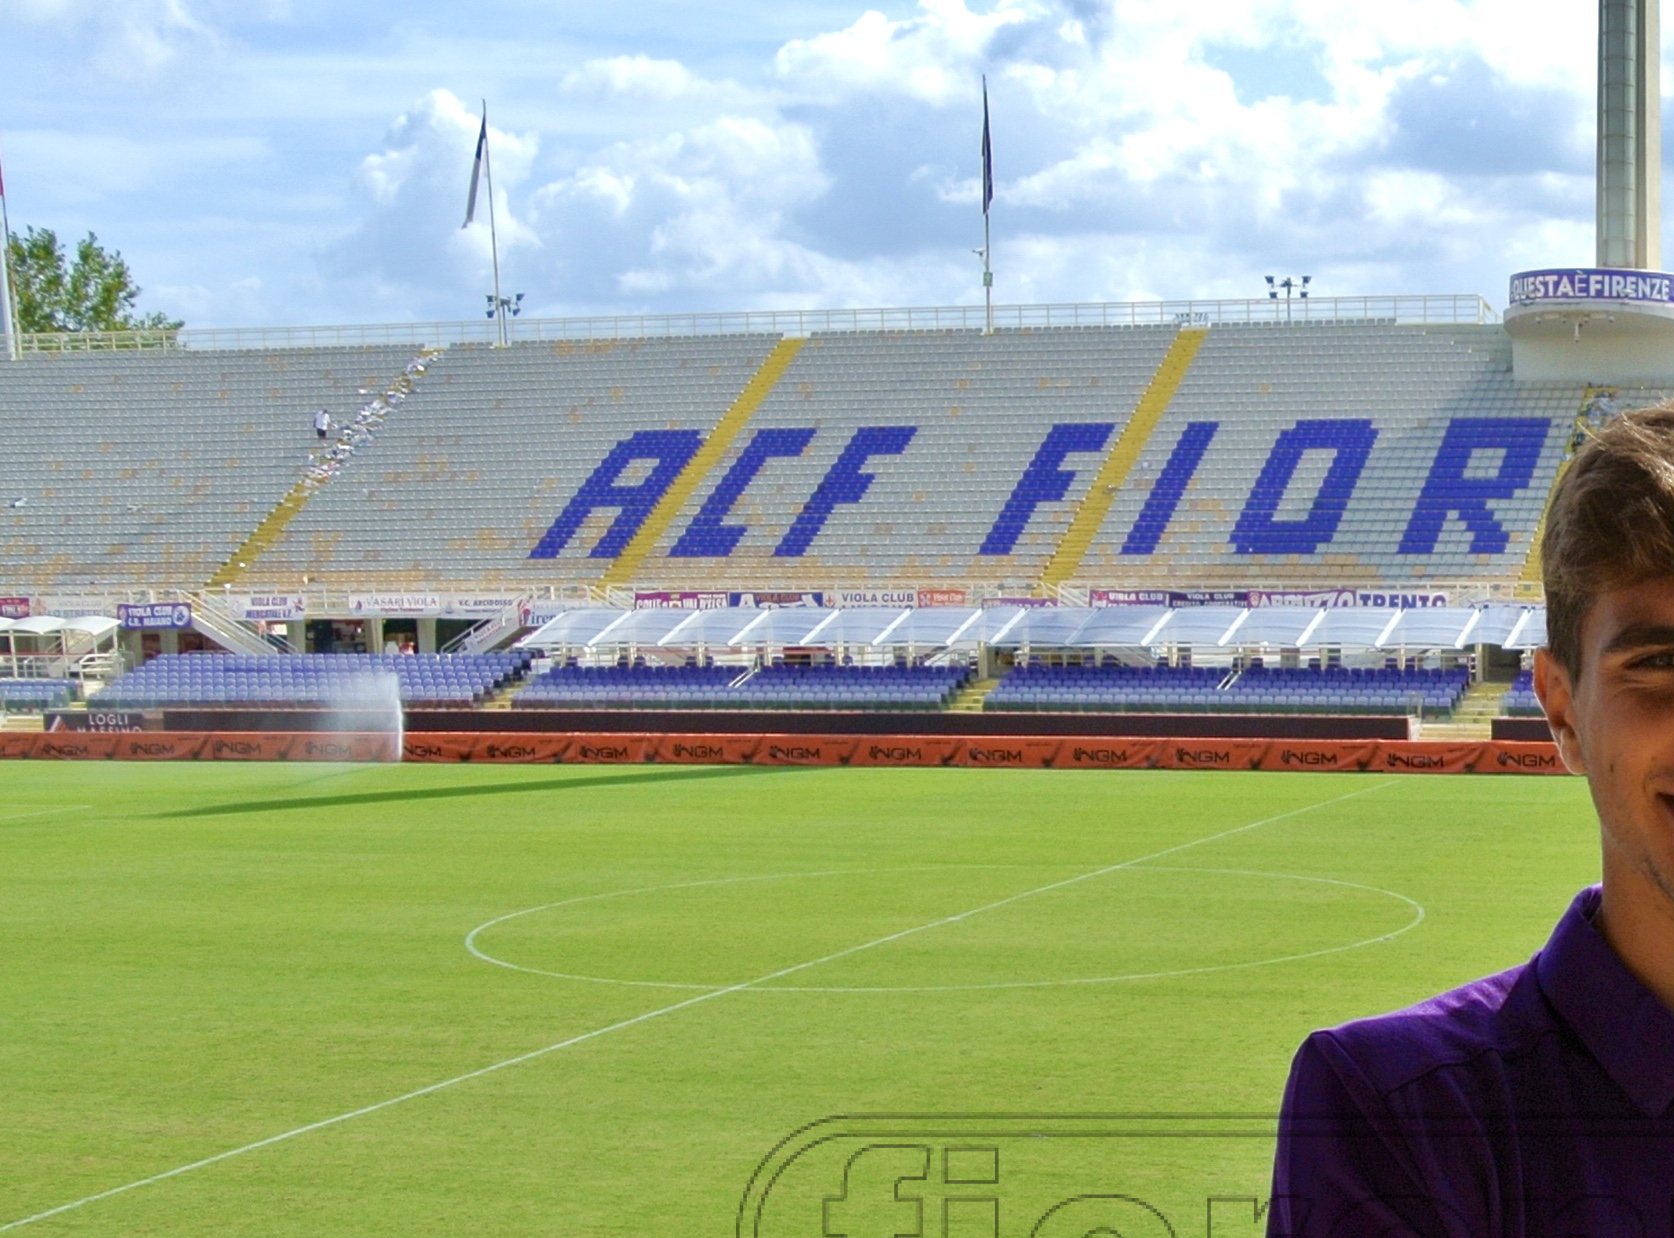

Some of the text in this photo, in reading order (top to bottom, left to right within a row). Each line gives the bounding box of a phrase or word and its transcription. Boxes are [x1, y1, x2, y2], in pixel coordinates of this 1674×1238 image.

[528, 426, 917, 558] ACF
[841, 593, 914, 602] VIOLA CLUB
[1108, 592, 1163, 601] VIOLA CLUB
[1360, 593, 1447, 608] TRENTO
[128, 606, 173, 616] VIOLA CLUB
[88, 714, 129, 725] LOGLI
[404, 745, 442, 757] NGM
[494, 746, 536, 758] NGM
[589, 747, 628, 758] NGM
[681, 746, 724, 758] NGM
[778, 747, 821, 759] NGM
[877, 748, 922, 760] NGM
[978, 750, 1022, 762] NGM
[1082, 749, 1127, 762] NGM
[1184, 750, 1229, 763] NGM
[1290, 752, 1338, 765] NGM
[1396, 755, 1444, 768] NGM
[1506, 753, 1556, 767] NGM
